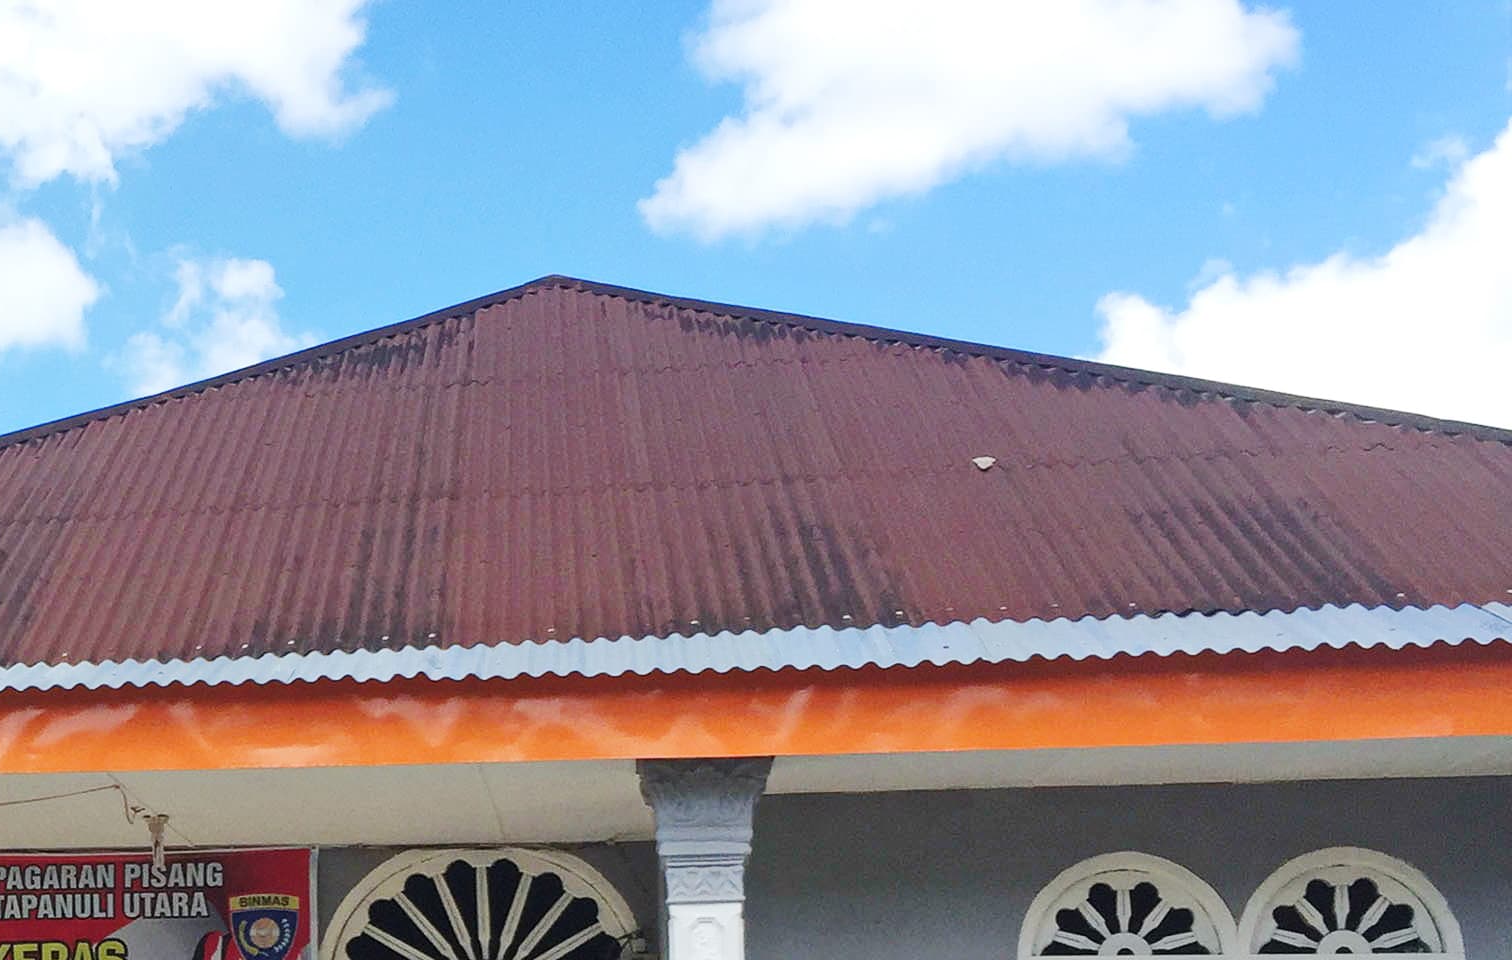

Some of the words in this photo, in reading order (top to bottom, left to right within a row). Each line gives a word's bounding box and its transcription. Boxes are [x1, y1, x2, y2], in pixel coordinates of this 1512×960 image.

[124, 862, 224, 888] PISANG
[123, 891, 209, 918] UTARA
[239, 895, 290, 908] BINMAS
